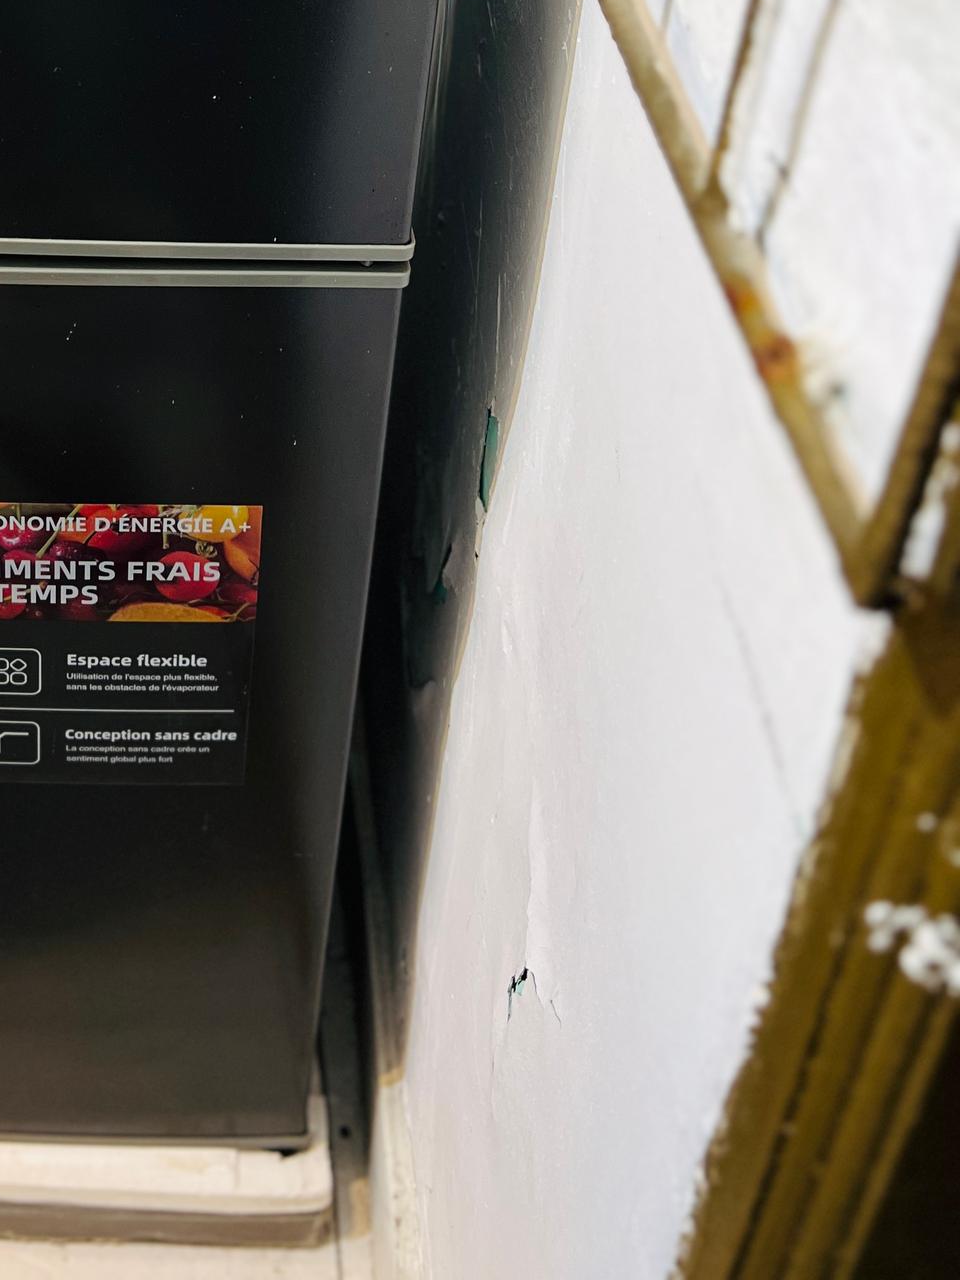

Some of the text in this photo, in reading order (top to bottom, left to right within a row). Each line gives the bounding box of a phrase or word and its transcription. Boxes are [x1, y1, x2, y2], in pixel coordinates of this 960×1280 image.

[94, 514, 213, 534] D'ÉNERGIE
[220, 518, 252, 534] A+
[127, 561, 221, 583] FRAIS
[66, 654, 208, 669] Espace flexible
[66, 672, 218, 682] Utilisation de l'espace plus flexible,
[104, 684, 146, 692] obstacles
[148, 684, 160, 692] de
[162, 684, 219, 693] l'évaporateur
[65, 729, 238, 742] Conception sans cadre
[65, 744, 77, 752] La
[79, 745, 126, 754] conception
[66, 755, 108, 763] sentiment
[110, 756, 137, 764] global
[138, 756, 156, 764] plus
